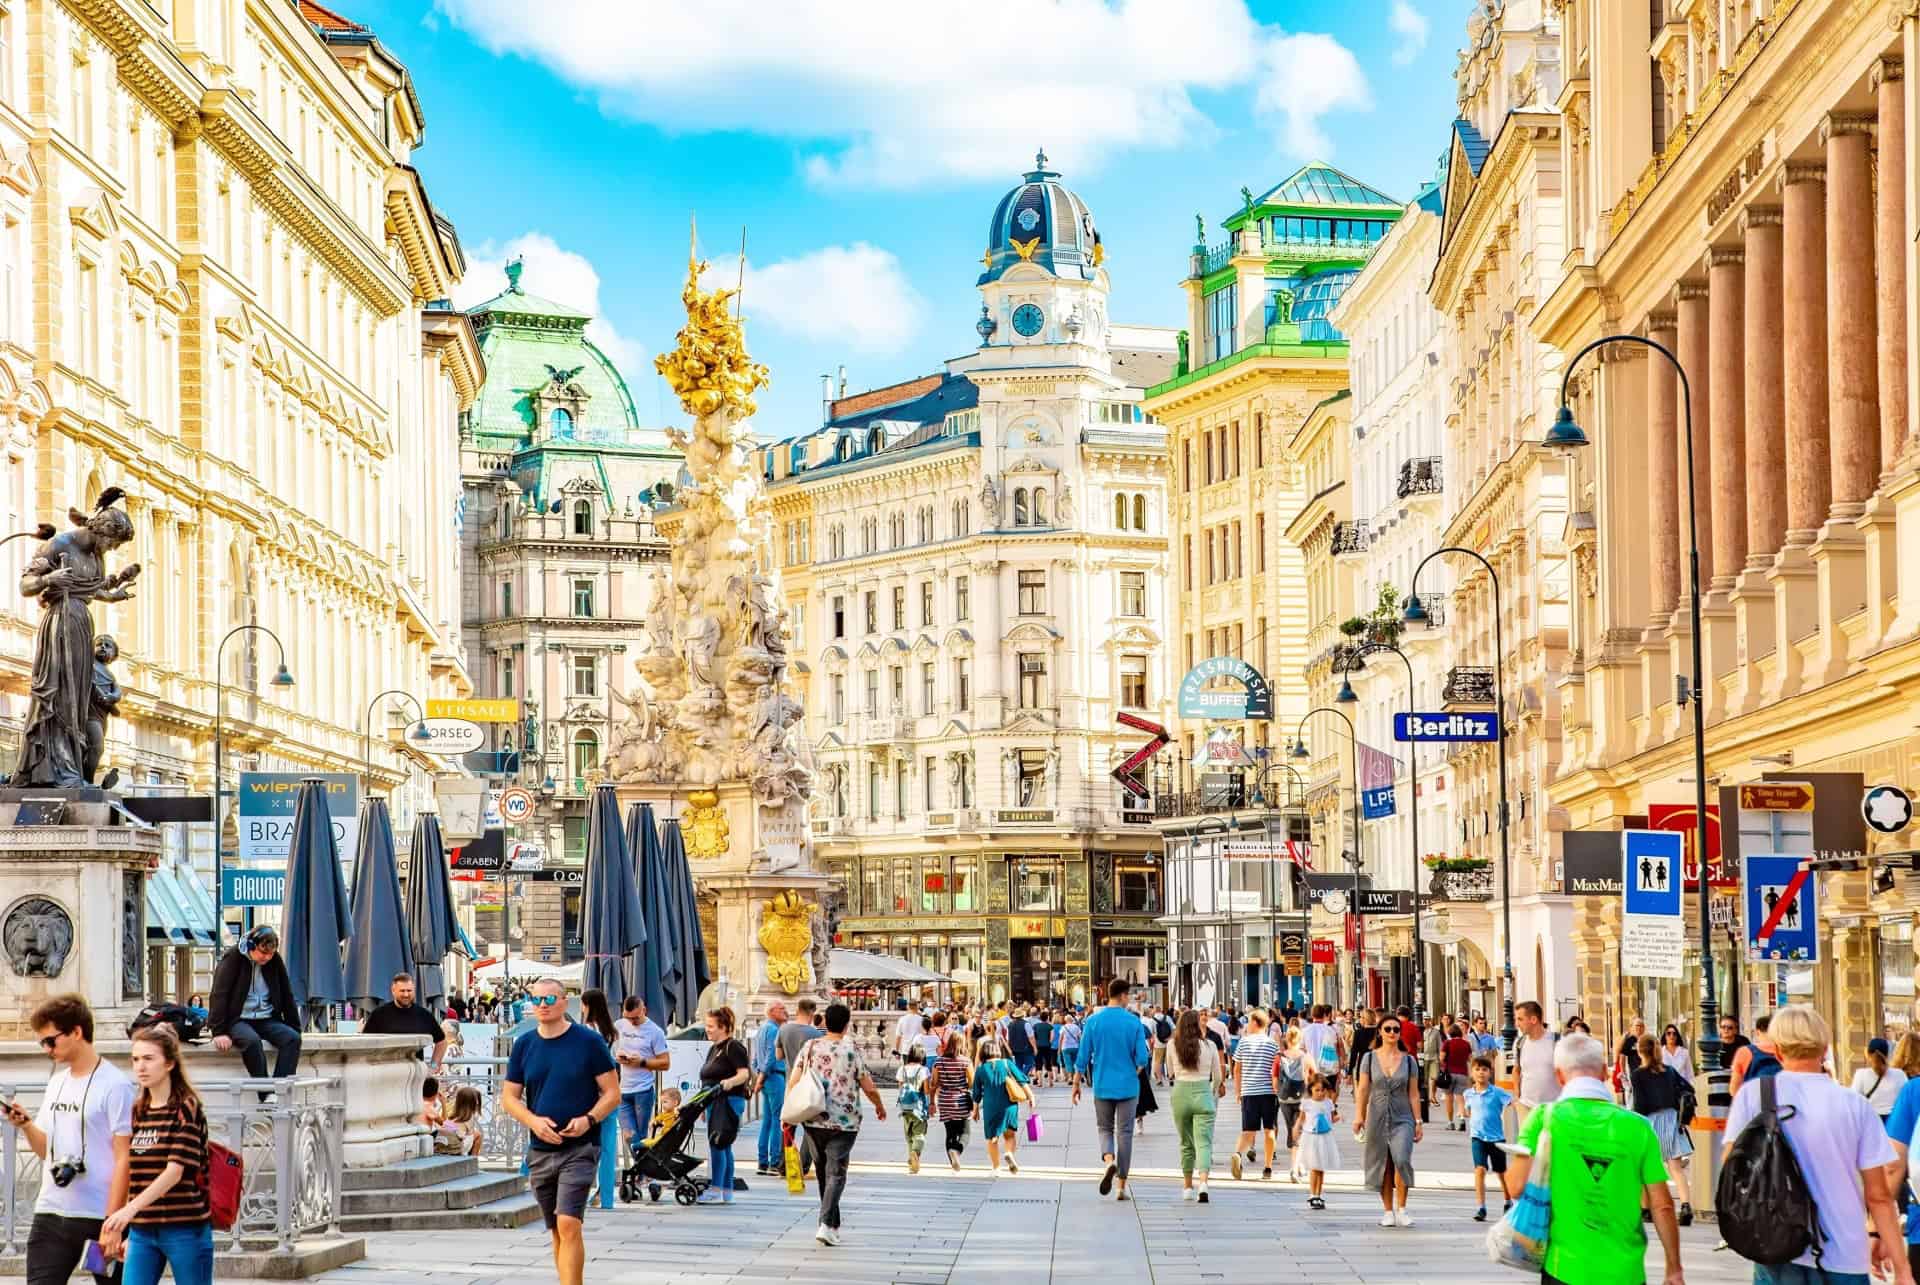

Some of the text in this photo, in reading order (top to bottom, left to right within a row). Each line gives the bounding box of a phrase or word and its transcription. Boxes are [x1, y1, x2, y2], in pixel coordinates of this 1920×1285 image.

[1199, 694, 1250, 706] BUFFET
[434, 703, 508, 717] VERSACE
[1406, 715, 1489, 736] Berlitz
[458, 856, 499, 867] GRABEN
[1367, 893, 1393, 905] IWC
